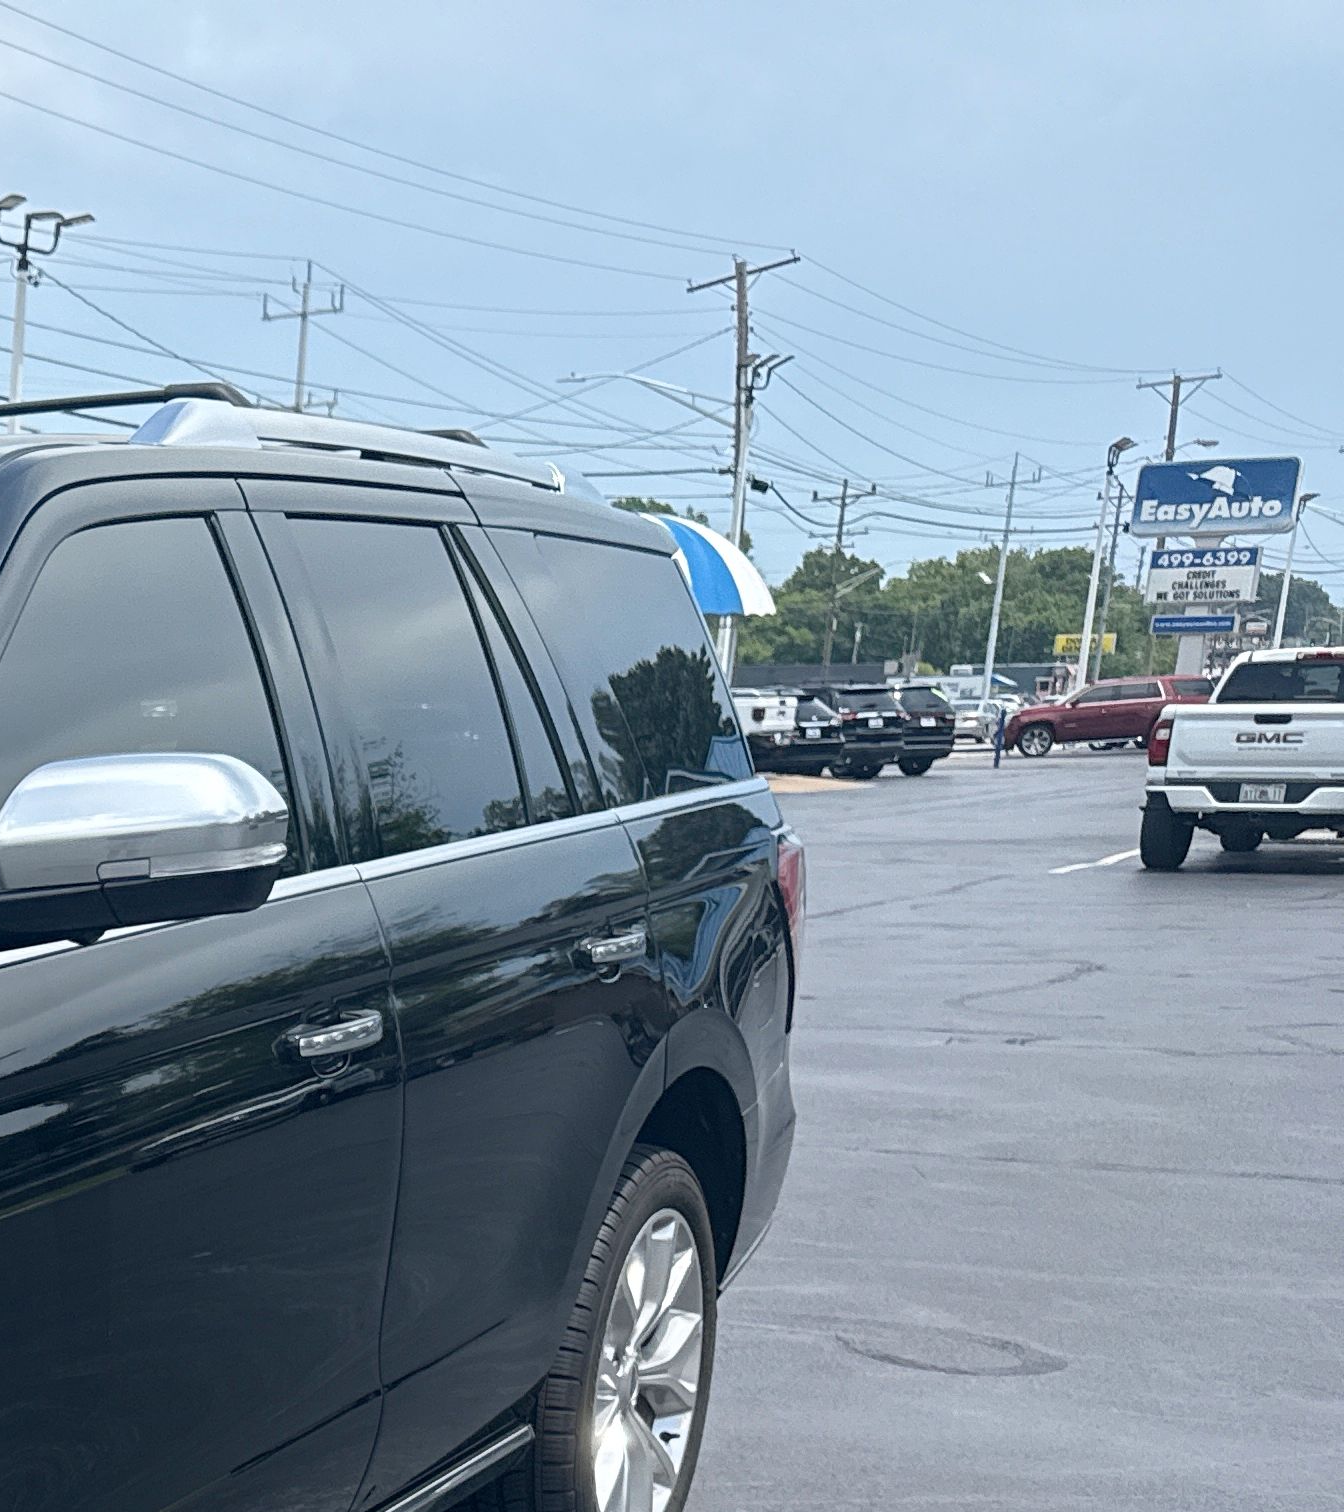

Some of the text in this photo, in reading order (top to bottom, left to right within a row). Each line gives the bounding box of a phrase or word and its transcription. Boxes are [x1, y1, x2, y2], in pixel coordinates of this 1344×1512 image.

[1140, 496, 1282, 529] EasyAuto
[1157, 551, 1251, 567] 499-6399
[1186, 570, 1216, 579] CREDIT
[1171, 580, 1226, 590] CHALLENGES
[1173, 591, 1190, 600] GOT
[1193, 589, 1240, 600] SOLUTIONS
[1235, 732, 1304, 744] GMC
